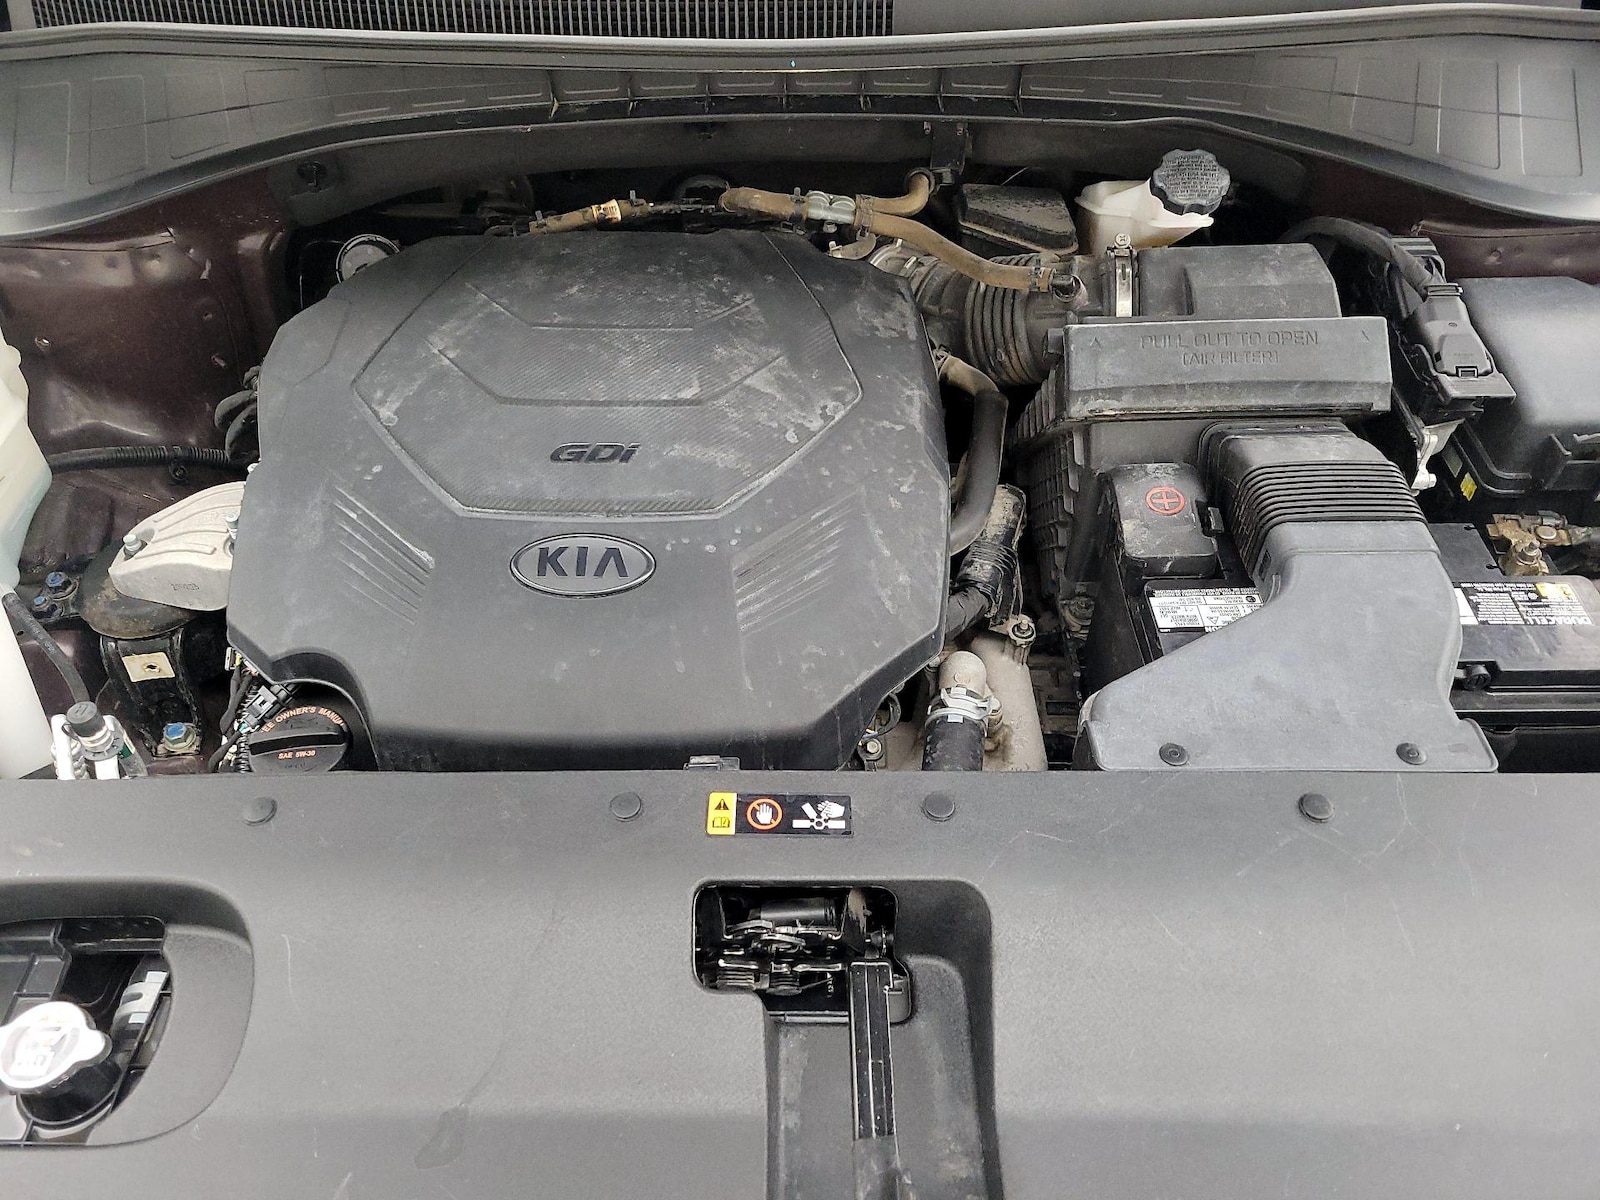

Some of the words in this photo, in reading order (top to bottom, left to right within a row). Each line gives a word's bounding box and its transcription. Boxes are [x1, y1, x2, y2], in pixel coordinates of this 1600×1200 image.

[1140, 335, 1189, 349] PULL
[1194, 332, 1231, 348] OUT
[1238, 331, 1262, 347] TO
[1267, 330, 1319, 346] OPEN
[537, 546, 629, 578] KIA
[1526, 617, 1592, 625] DURACELL
[260, 720, 277, 733] EE
[275, 706, 317, 723] OWNER'S
[278, 751, 293, 760] SAE
[295, 750, 317, 759] 5W-30
